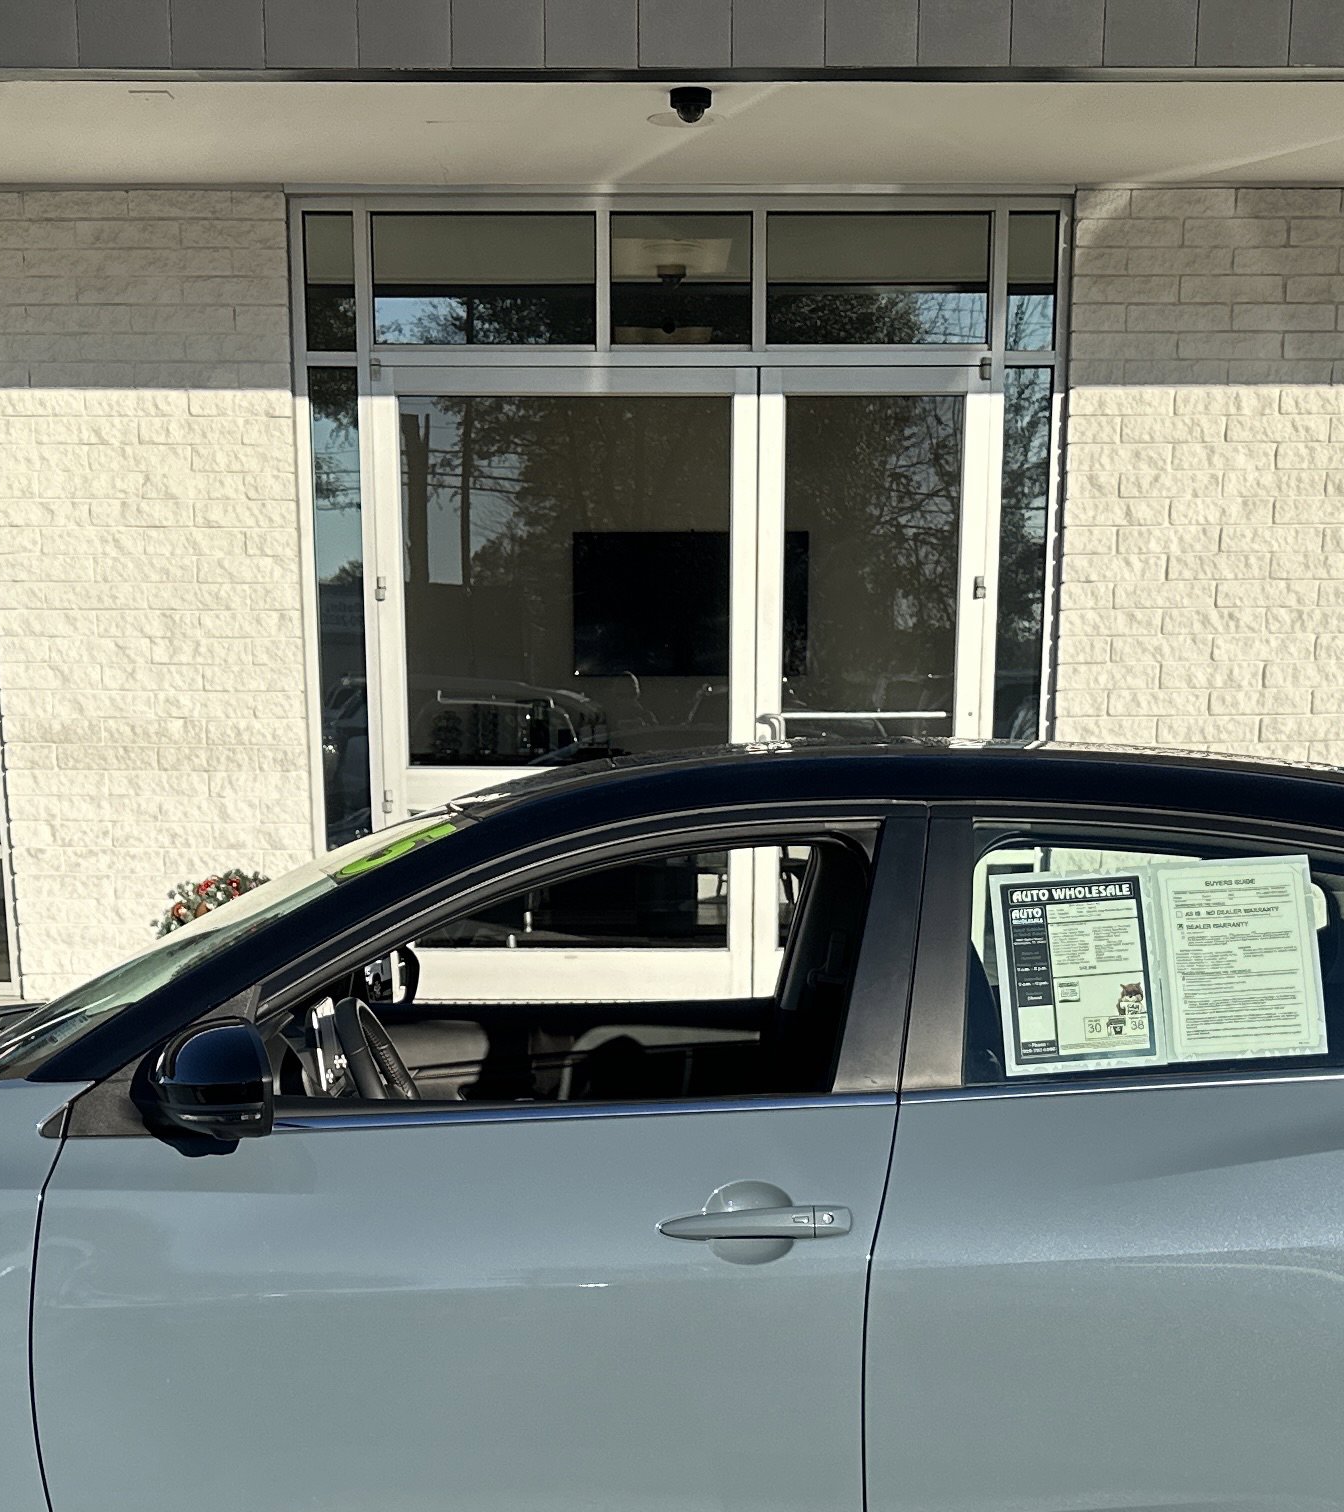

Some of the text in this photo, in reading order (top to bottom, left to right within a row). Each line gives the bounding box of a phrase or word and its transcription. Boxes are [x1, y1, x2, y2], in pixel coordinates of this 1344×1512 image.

[1012, 884, 1131, 903] AUTO WHOLESALE
[1011, 907, 1042, 920] AUTO
[1087, 1019, 1145, 1034] 30 38
